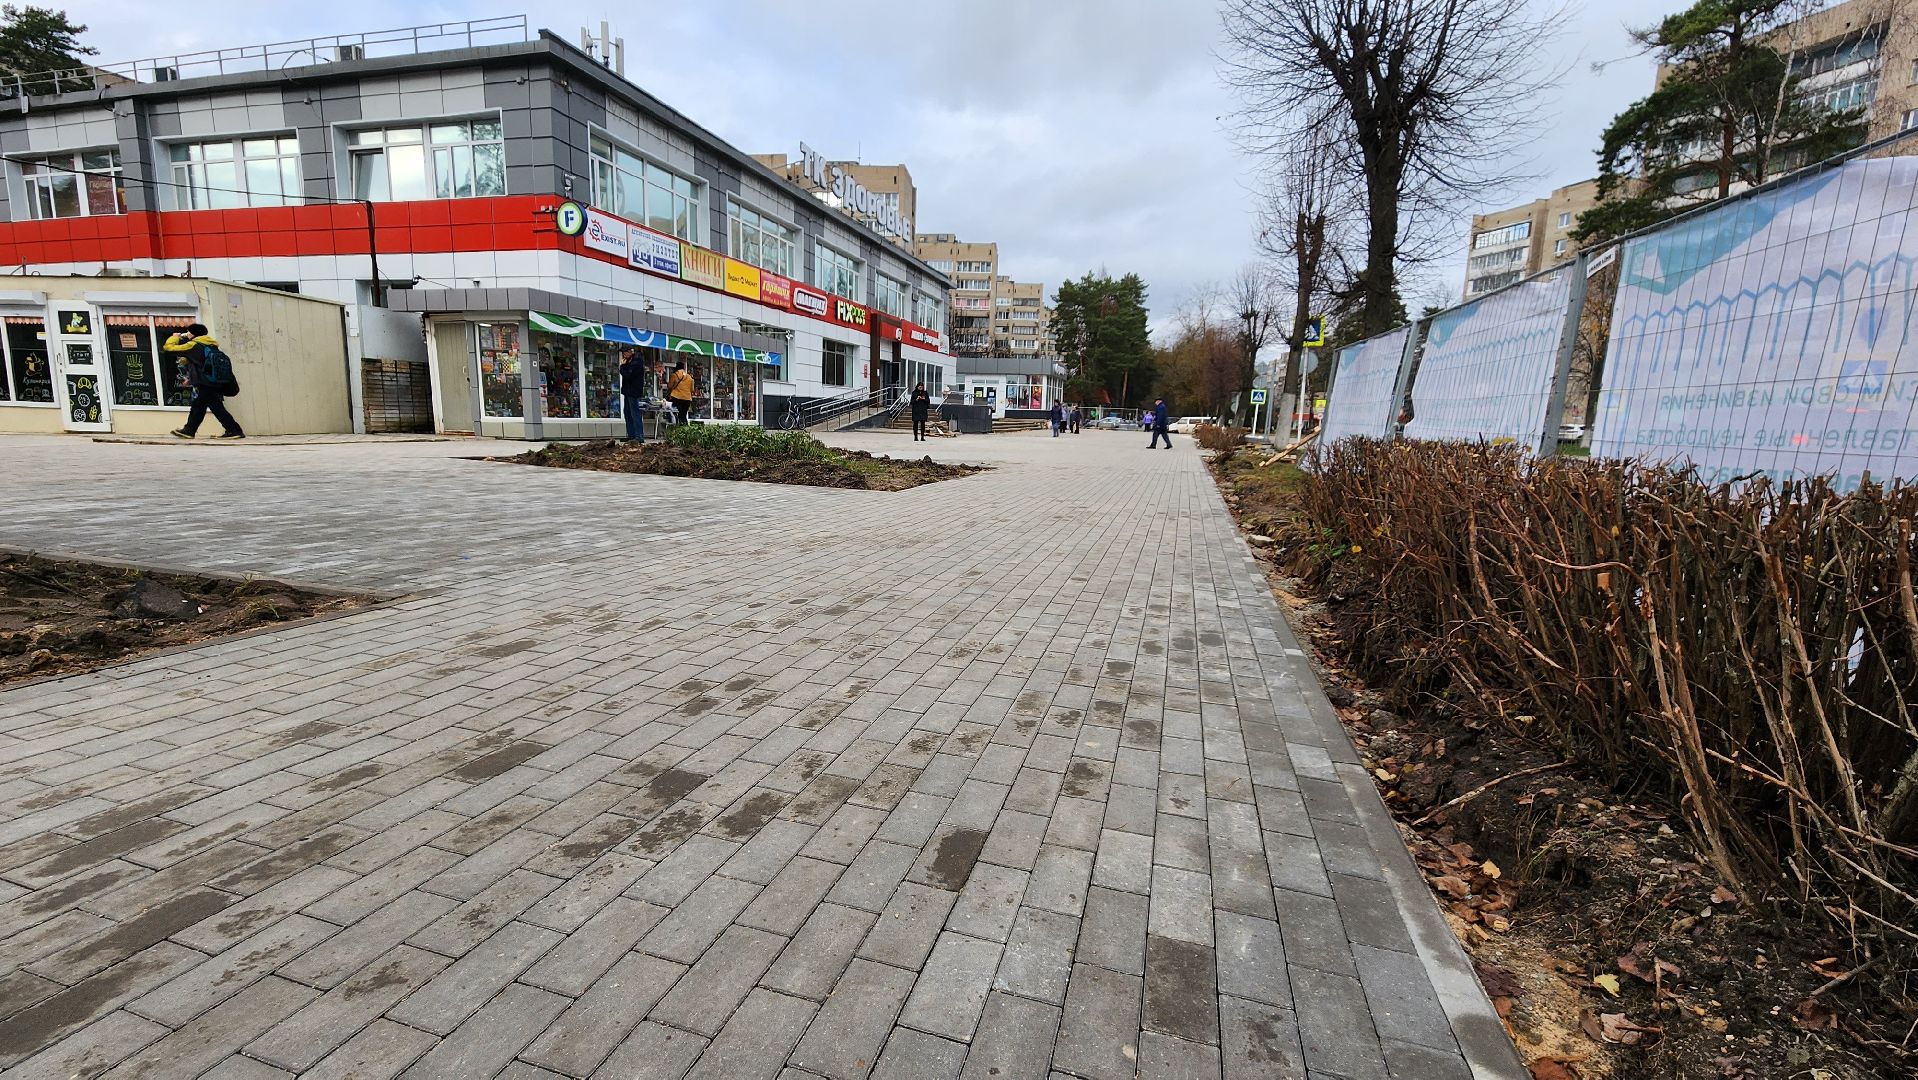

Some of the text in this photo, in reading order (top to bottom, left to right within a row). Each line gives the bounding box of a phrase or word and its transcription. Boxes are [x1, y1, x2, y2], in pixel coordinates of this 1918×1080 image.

[800, 141, 911, 243] ТК ЗДОРОВЬЕ
[564, 210, 575, 228] F
[601, 234, 626, 248] EXIST.RU
[683, 246, 721, 278] КНИГИ
[727, 272, 740, 283] Яндекс
[744, 278, 758, 288] Маркет
[837, 299, 854, 323] FIX
